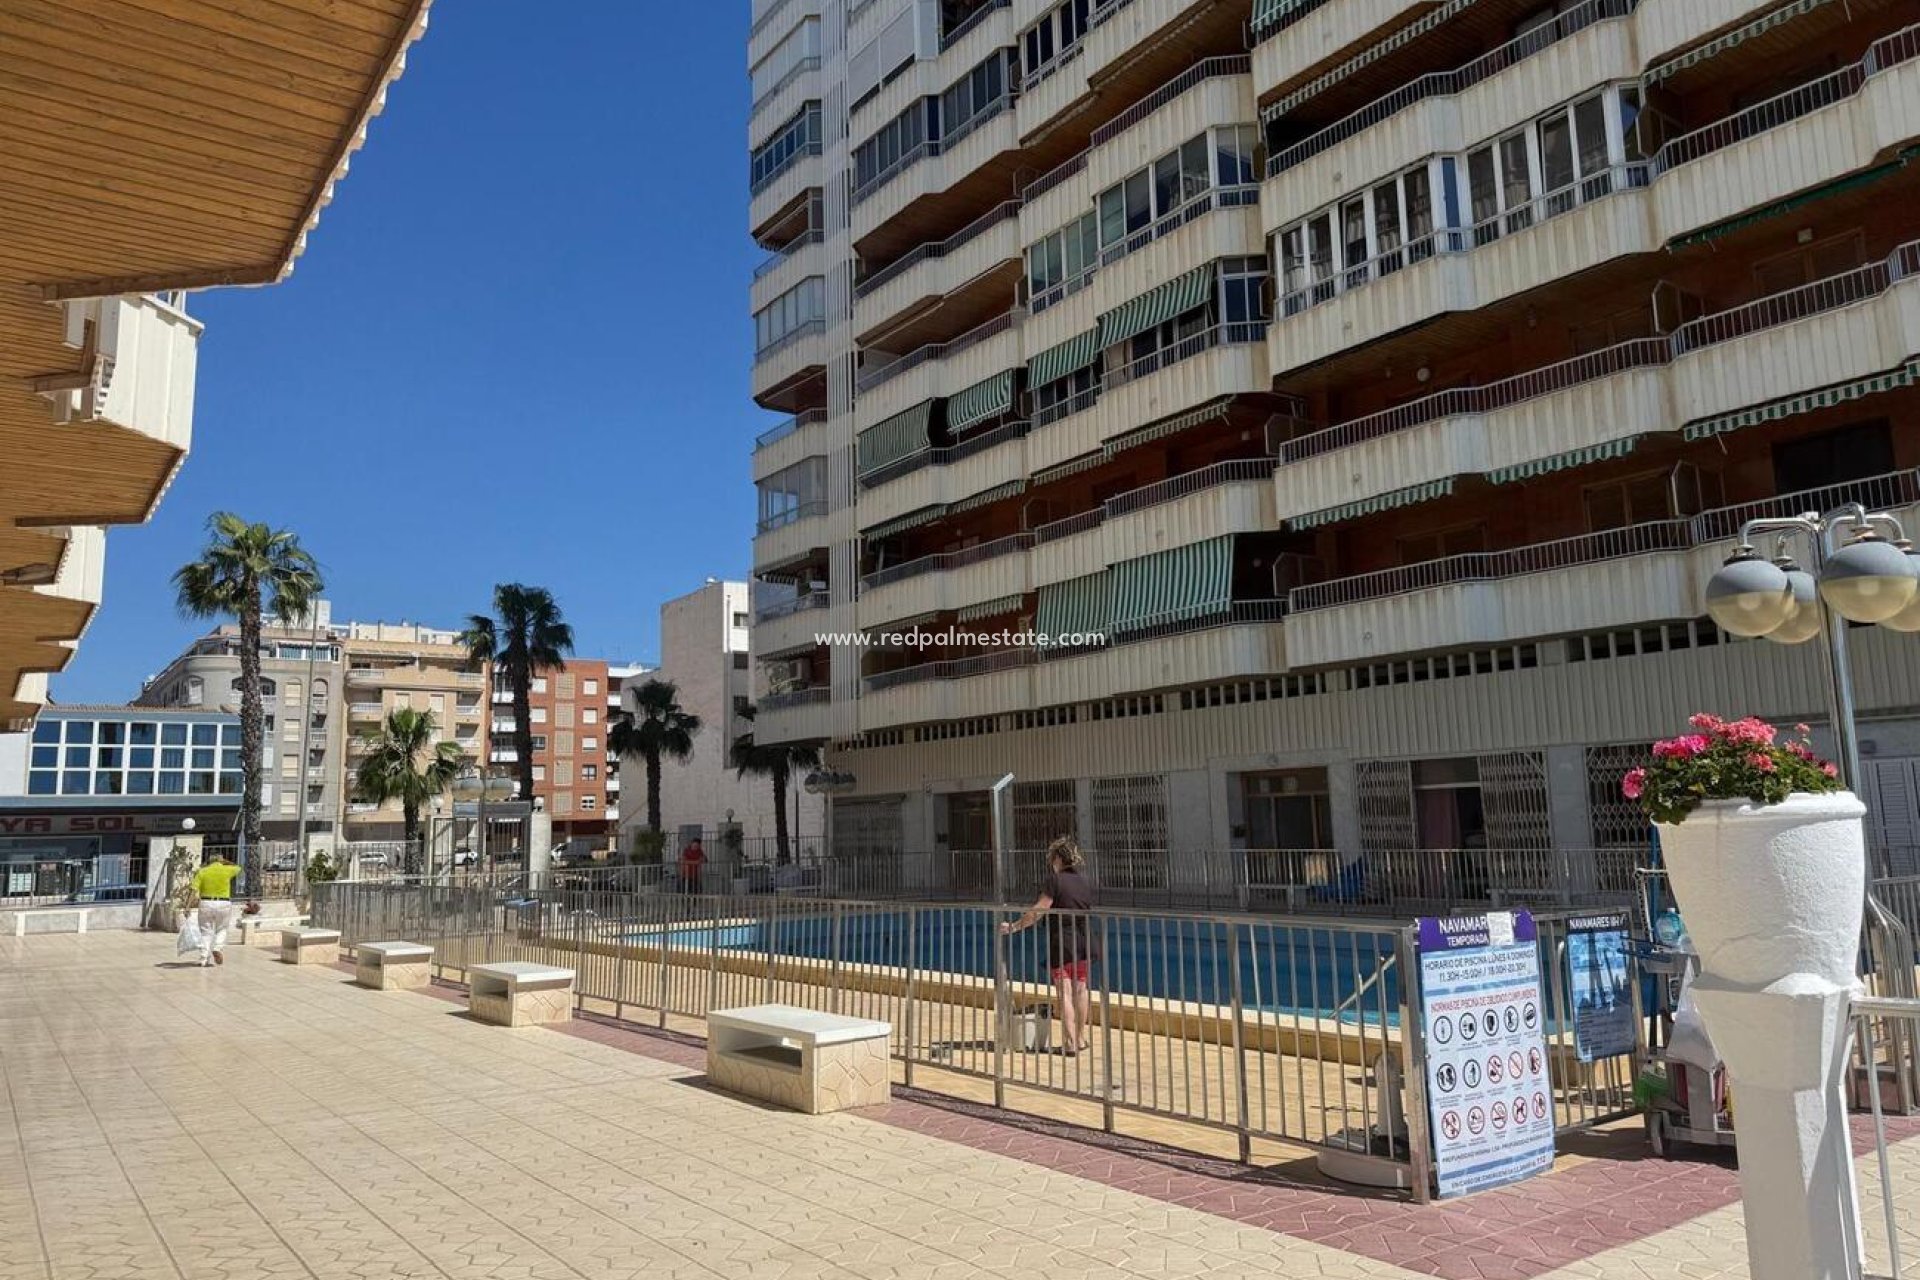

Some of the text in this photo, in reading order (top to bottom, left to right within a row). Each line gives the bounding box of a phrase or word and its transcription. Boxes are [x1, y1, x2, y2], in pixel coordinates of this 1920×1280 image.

[70, 816, 145, 832] SOL
[1439, 916, 1489, 934] NAVAMAR
[1447, 934, 1489, 947] TEMPORADA
[1425, 959, 1453, 971] HORARIO
[1454, 957, 1462, 967] DE
[1464, 954, 1487, 966] PISCINA
